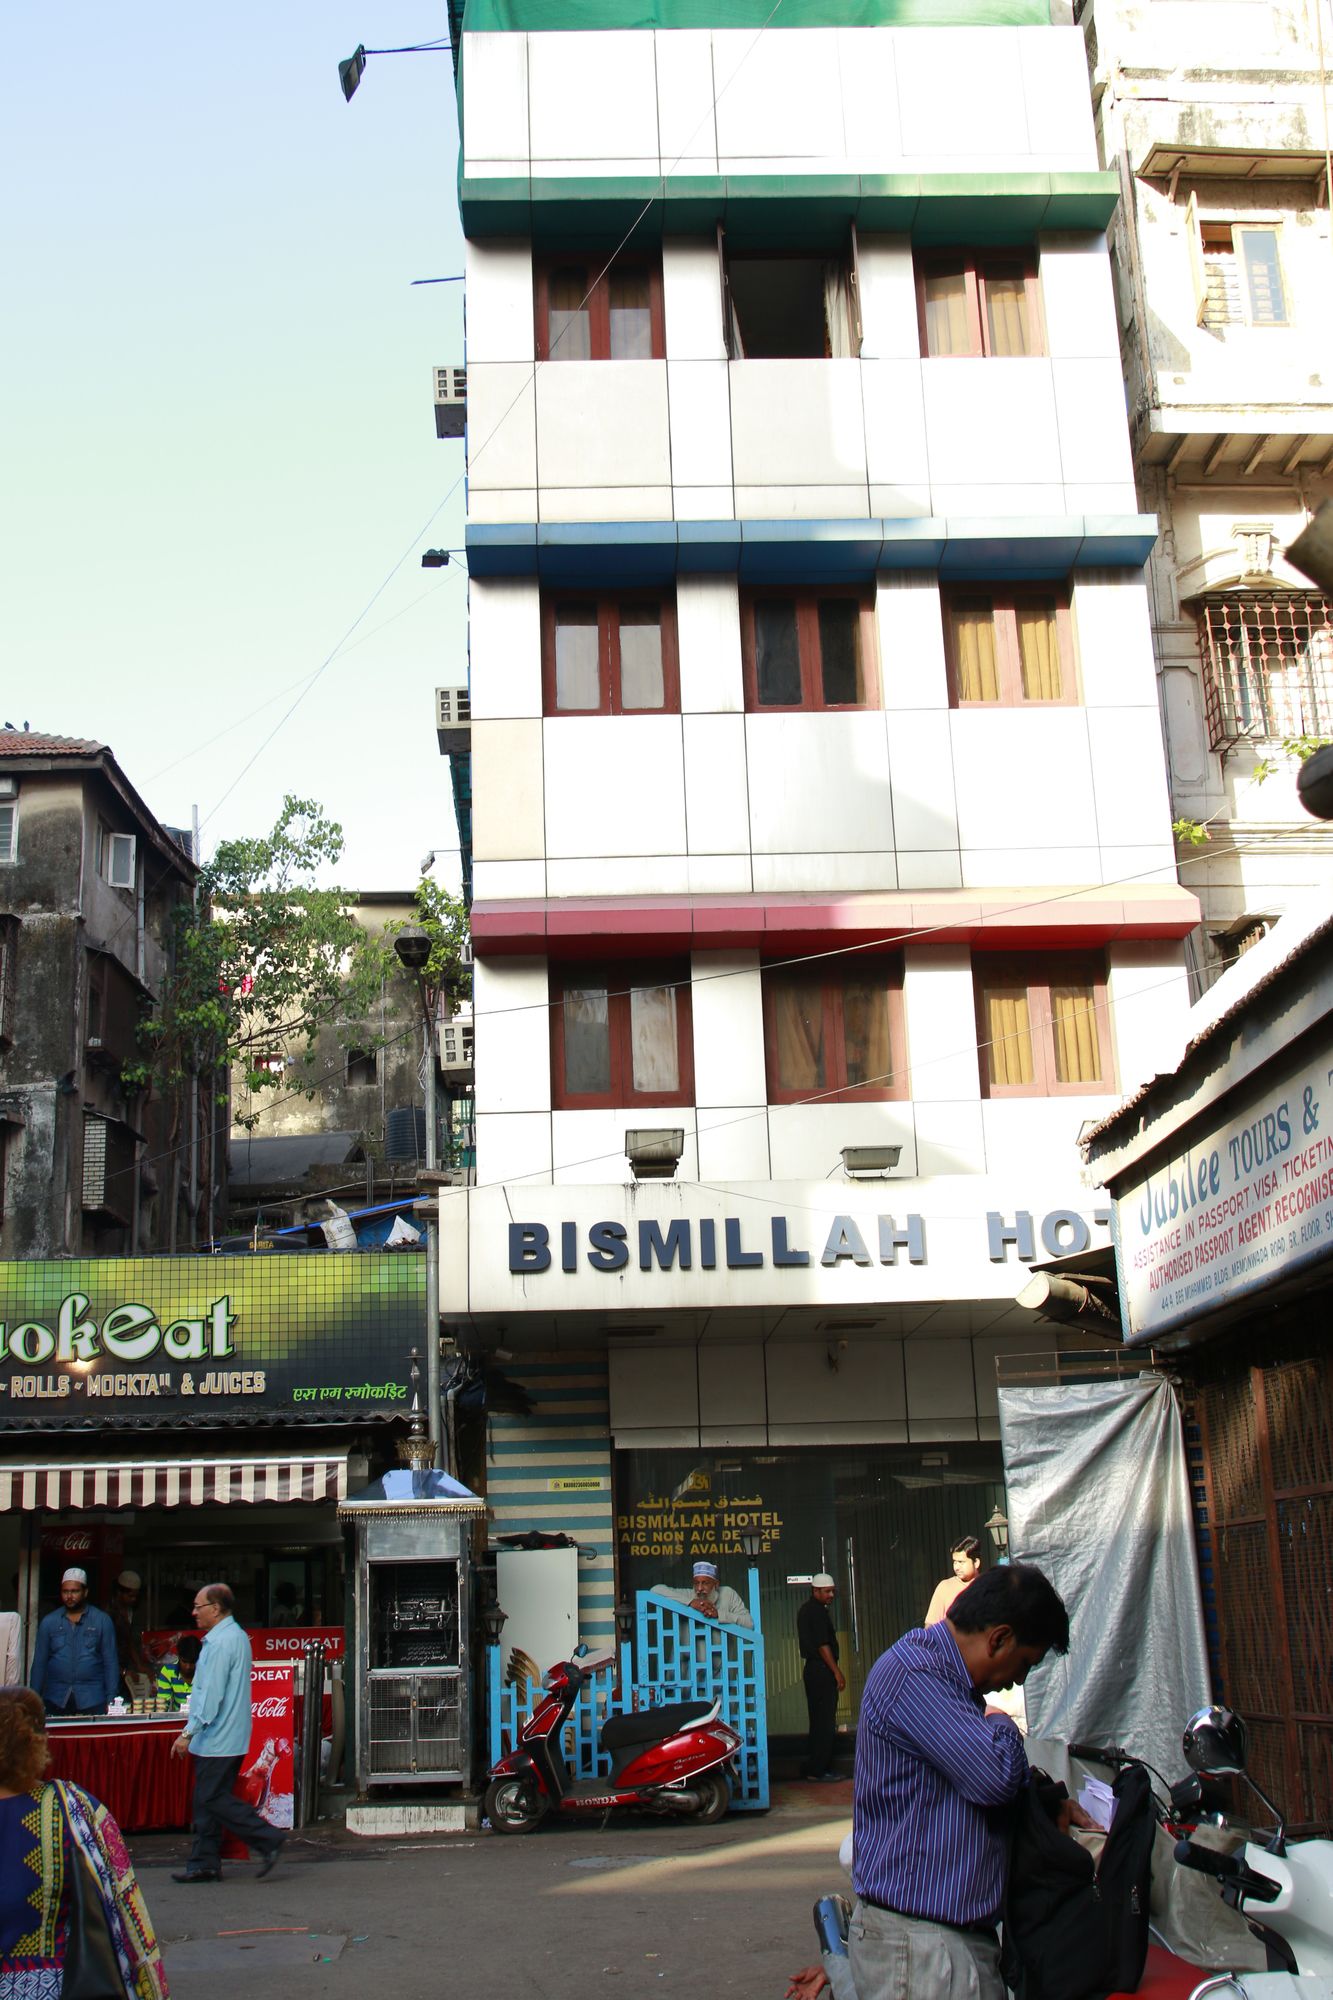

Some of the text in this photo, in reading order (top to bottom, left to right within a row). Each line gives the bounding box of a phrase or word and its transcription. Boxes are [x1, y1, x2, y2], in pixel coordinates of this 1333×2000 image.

[1141, 1086, 1319, 1235] Jubilee TOURS &
[509, 1215, 924, 1272] BISMILLAH
[1134, 1229, 1181, 1269] ASSISTANCE
[1185, 1220, 1195, 1241] IN
[1149, 1250, 1193, 1292] AUTHORISED
[1195, 1226, 1234, 1269] PASSPORT
[11, 1375, 70, 1398] ROLLS
[181, 1372, 195, 1395] &
[199, 1371, 266, 1394] JUICES
[293, 1388, 318, 1401] एस
[319, 1387, 343, 1400] एम
[723, 1512, 784, 1527] HOTEL
[621, 1528, 781, 1543] A/C NON A/C DEXE
[631, 1542, 772, 1556] ROOMS AVAILAE
[265, 1637, 341, 1651] SMOKAT
[576, 1795, 619, 1806] HONDA
